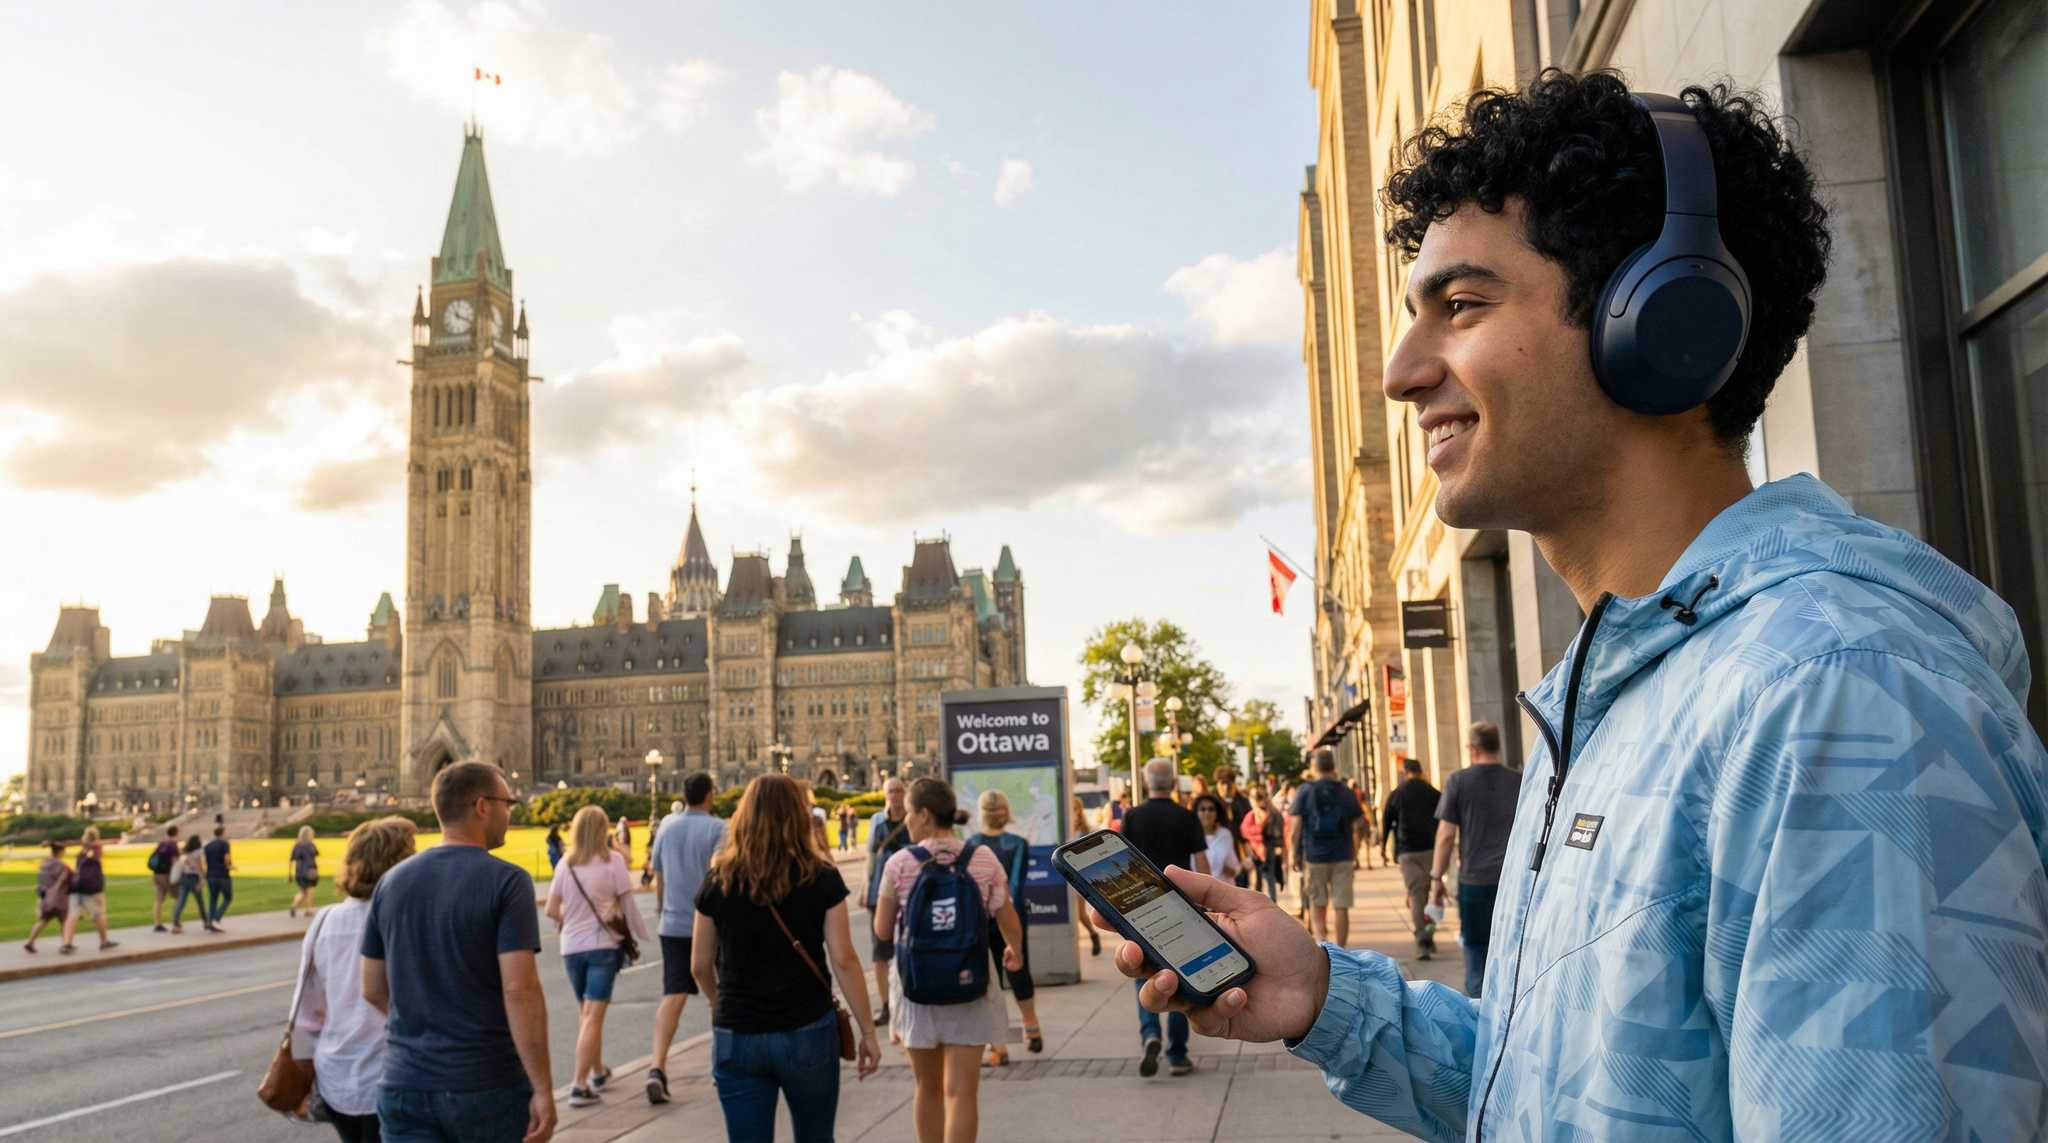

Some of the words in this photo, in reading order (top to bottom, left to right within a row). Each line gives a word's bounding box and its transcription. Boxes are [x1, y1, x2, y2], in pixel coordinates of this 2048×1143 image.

[956, 713, 1028, 728] Welcome
[1032, 712, 1050, 725] to
[957, 732, 1050, 754] Ottawa
